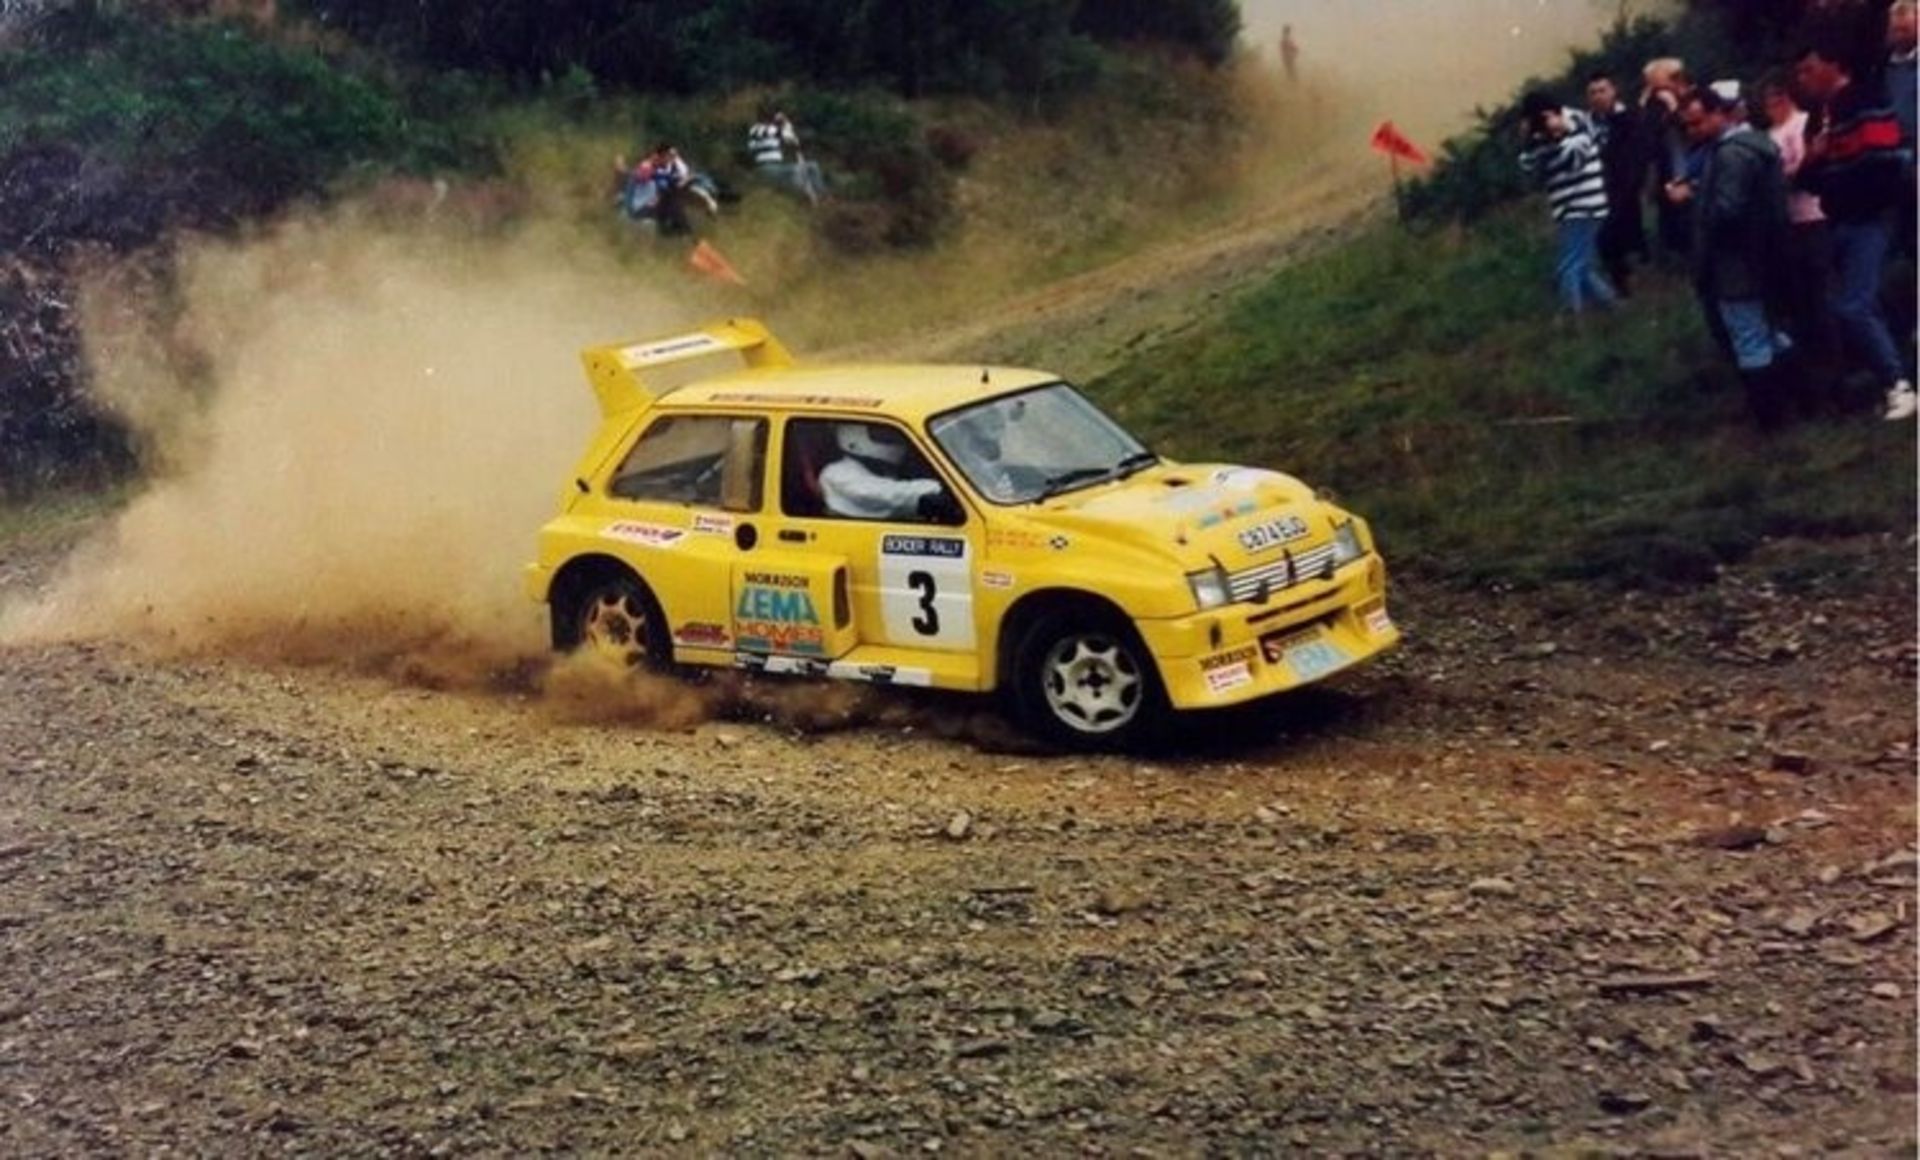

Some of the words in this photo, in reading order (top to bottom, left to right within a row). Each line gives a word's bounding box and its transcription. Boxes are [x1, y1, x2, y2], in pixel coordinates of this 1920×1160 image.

[885, 536, 925, 552] BORDER
[928, 540, 961, 554] RALLY
[744, 572, 810, 588] MORRISON
[908, 570, 940, 636] 3
